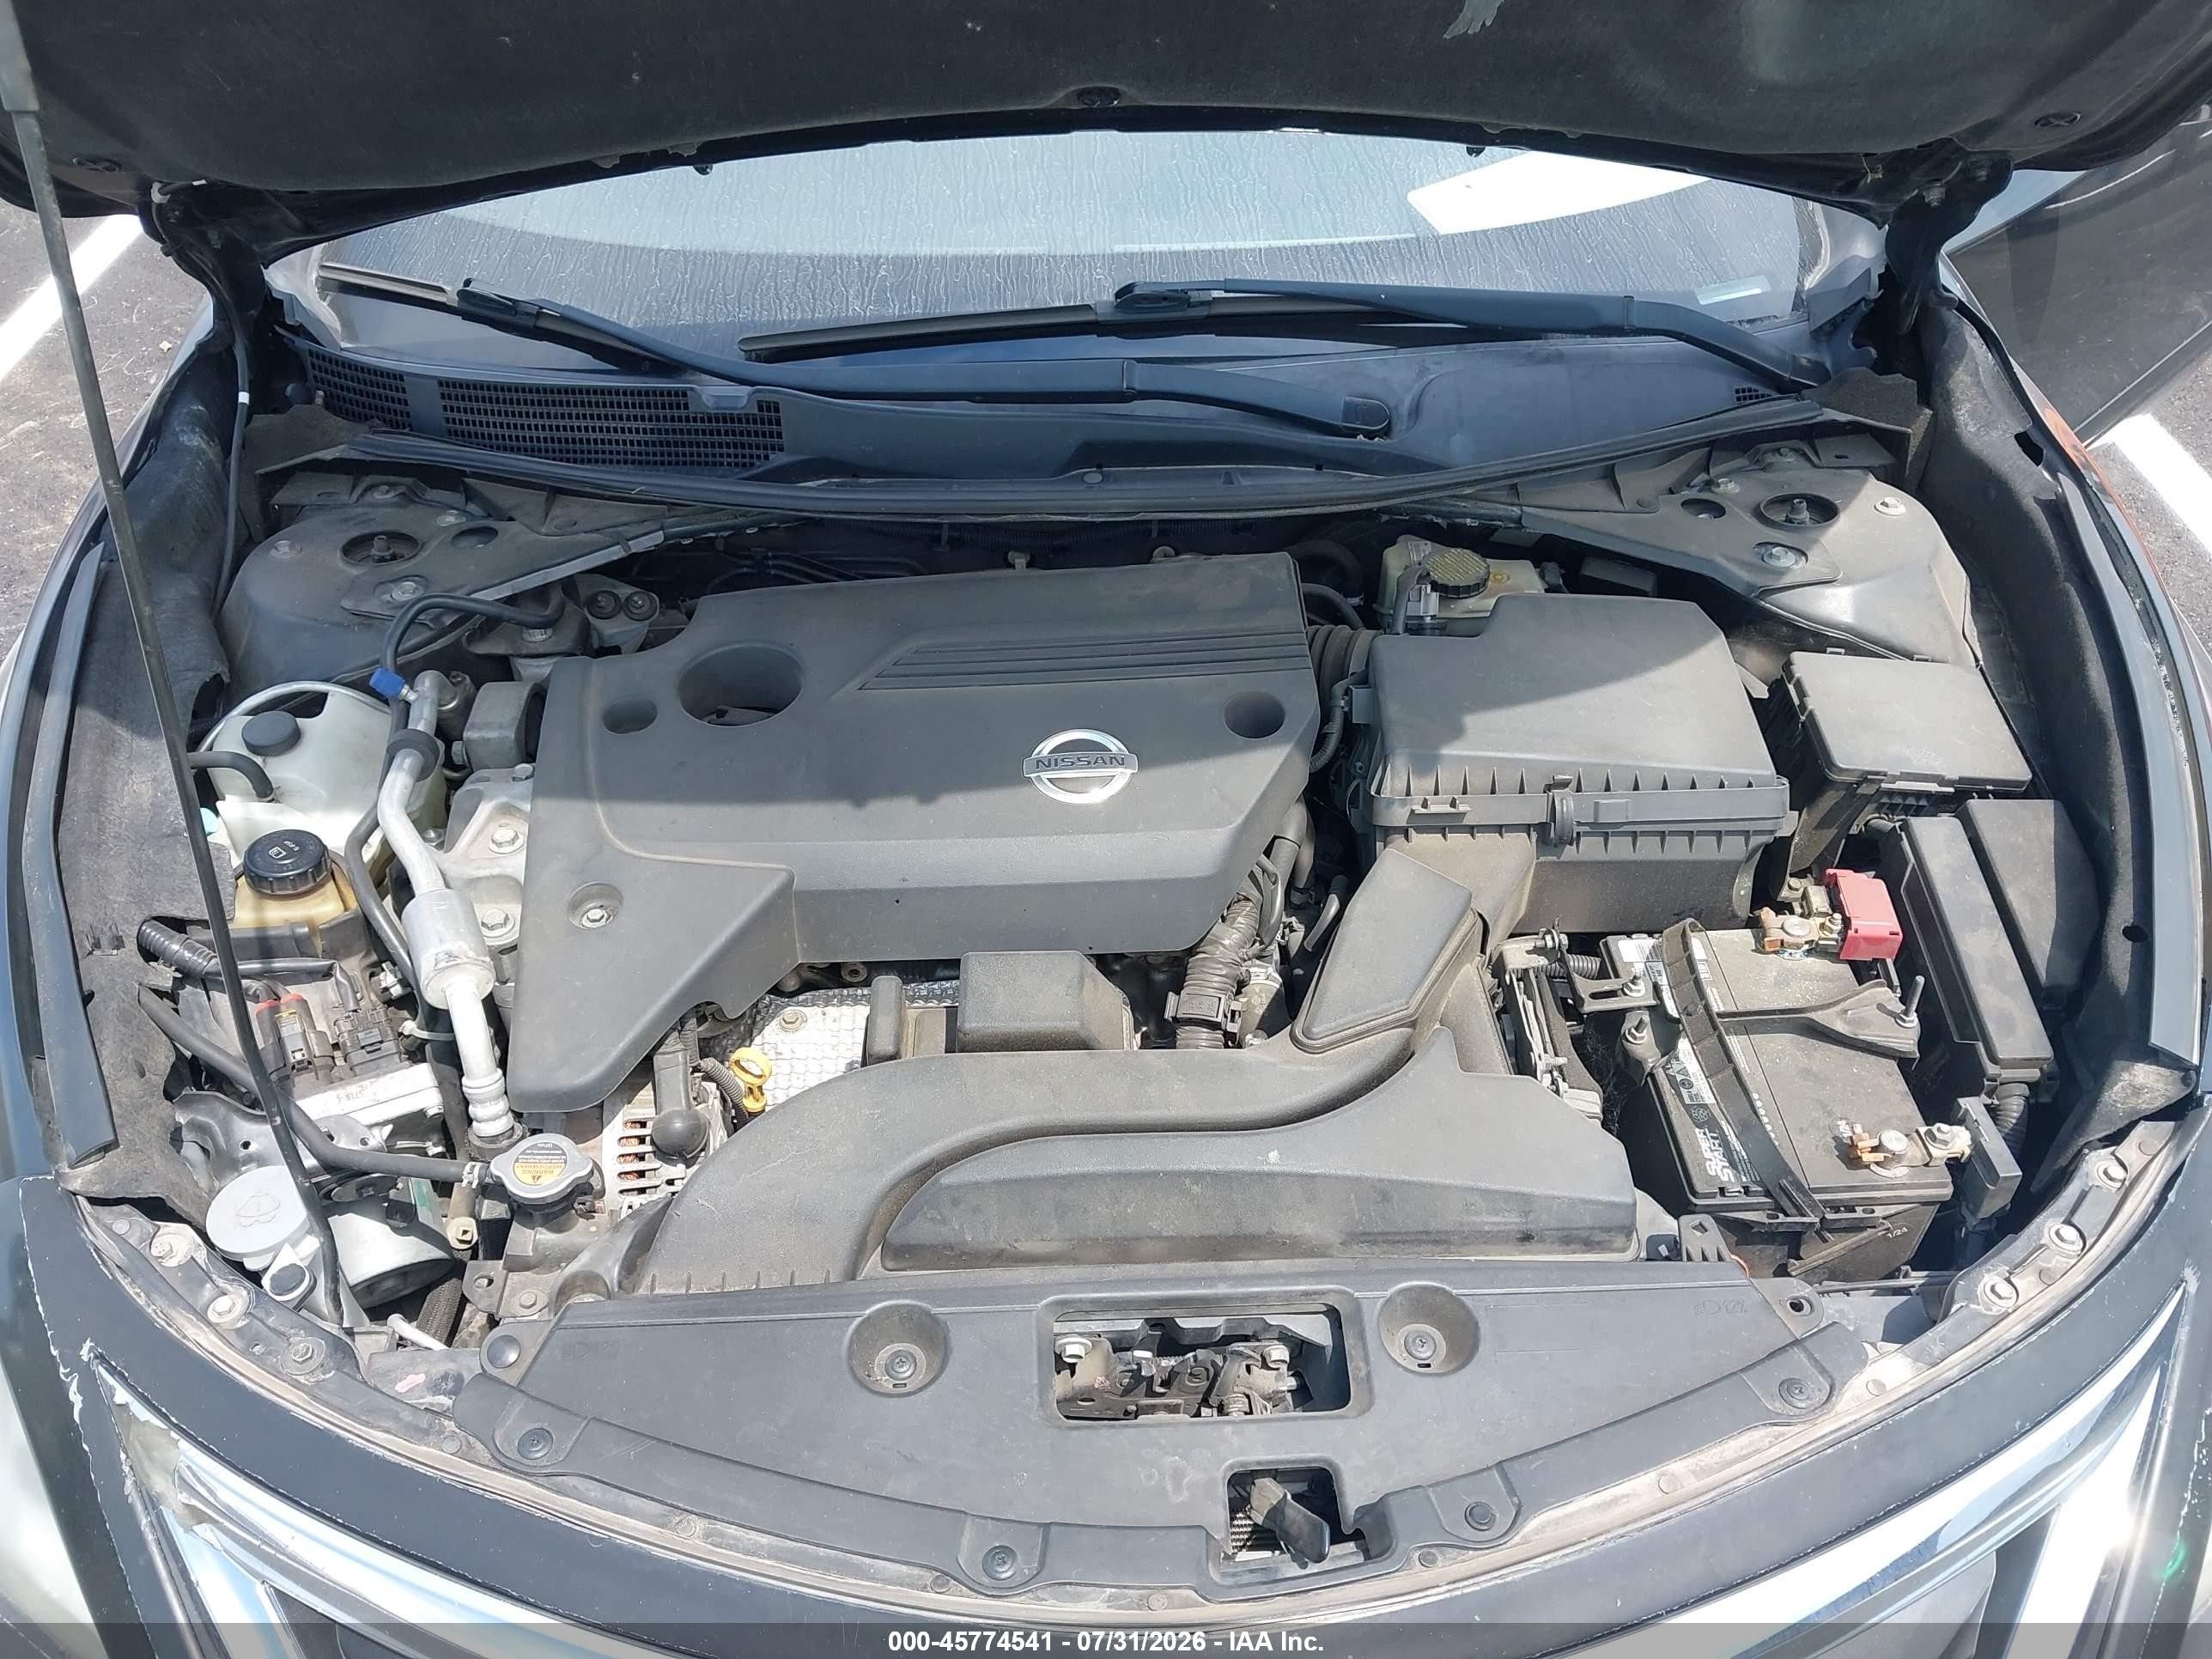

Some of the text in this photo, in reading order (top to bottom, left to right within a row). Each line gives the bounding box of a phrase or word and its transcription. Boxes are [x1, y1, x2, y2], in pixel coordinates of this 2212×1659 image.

[1036, 755, 1126, 770] NISSAN
[1694, 1127, 1717, 1176] SUPER
[1704, 1127, 1735, 1182] START
